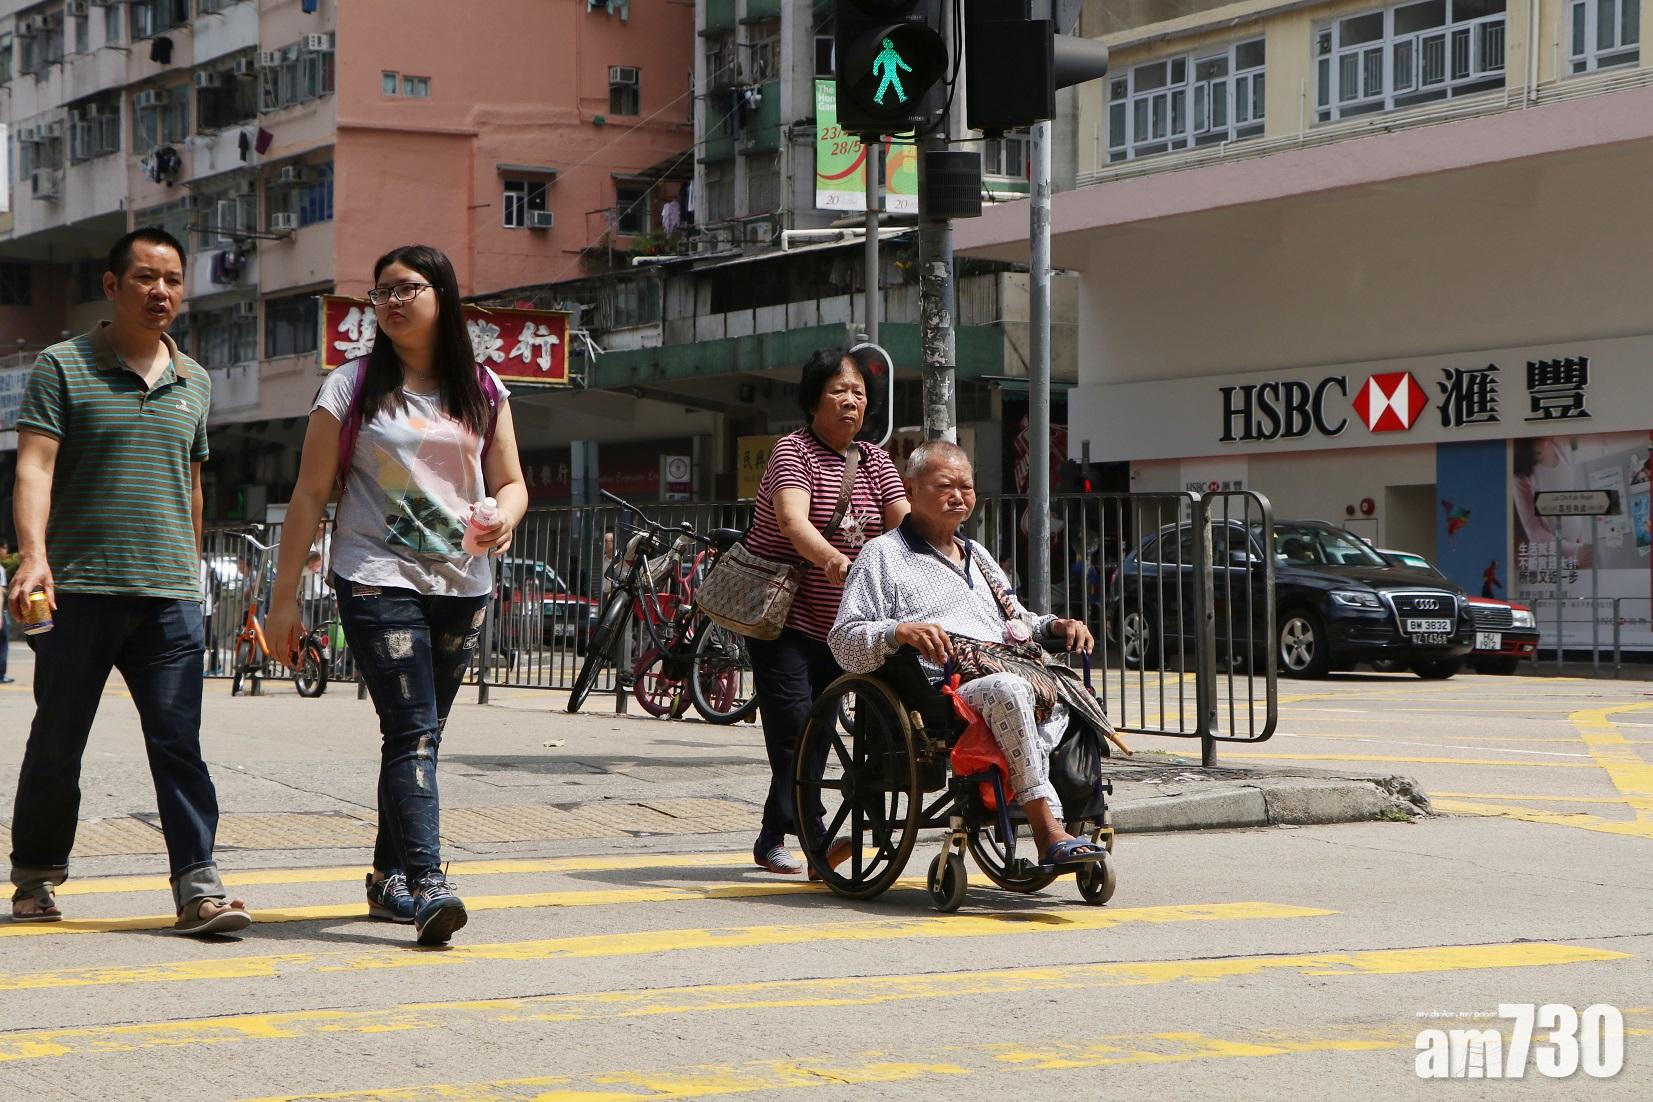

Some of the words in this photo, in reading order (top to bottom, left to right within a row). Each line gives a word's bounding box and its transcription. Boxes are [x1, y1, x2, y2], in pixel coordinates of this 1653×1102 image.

[818, 85, 834, 94] The
[831, 140, 861, 156] 28/5
[1218, 376, 1349, 442] HSBC
[1425, 621, 1448, 630] 3832
